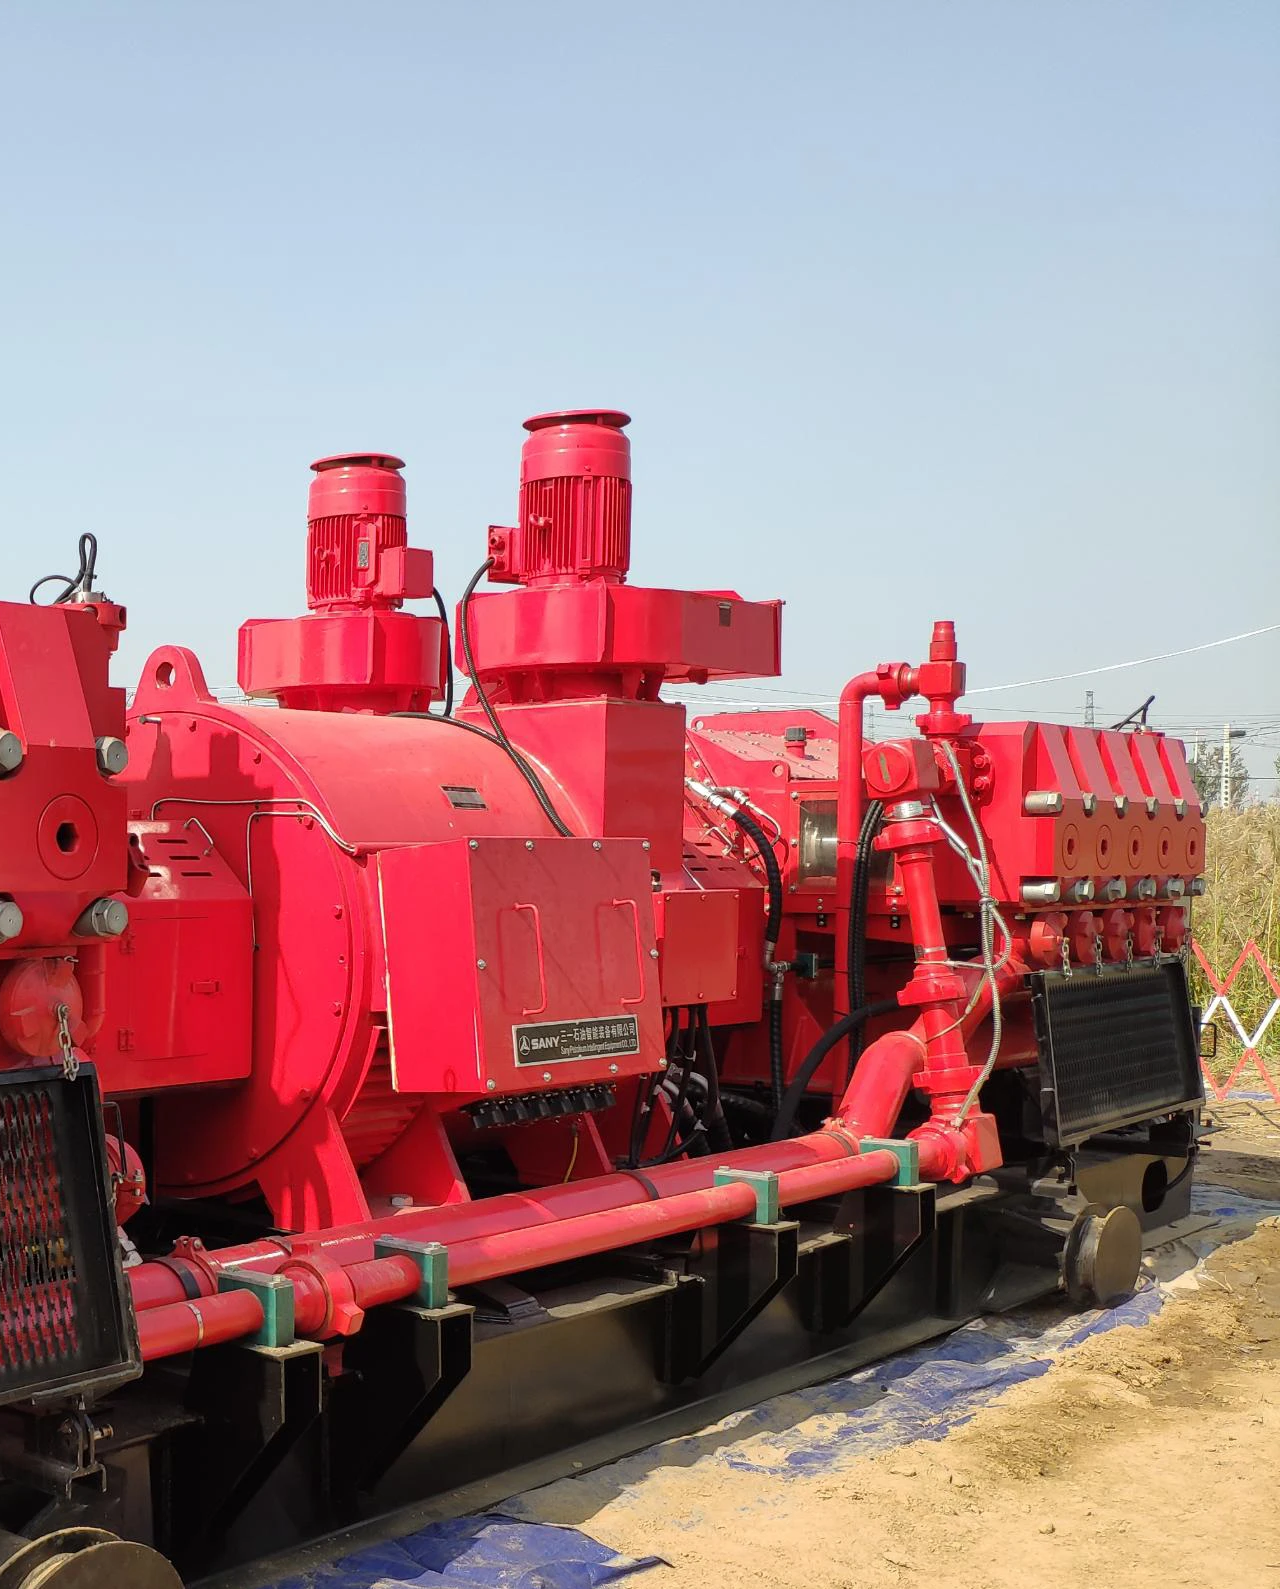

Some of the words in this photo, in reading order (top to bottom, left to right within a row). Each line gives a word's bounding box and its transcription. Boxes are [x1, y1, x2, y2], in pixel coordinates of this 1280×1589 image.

[560, 1023, 635, 1042] 三一石油智能装备有限公司
[531, 1036, 560, 1050] SANY
